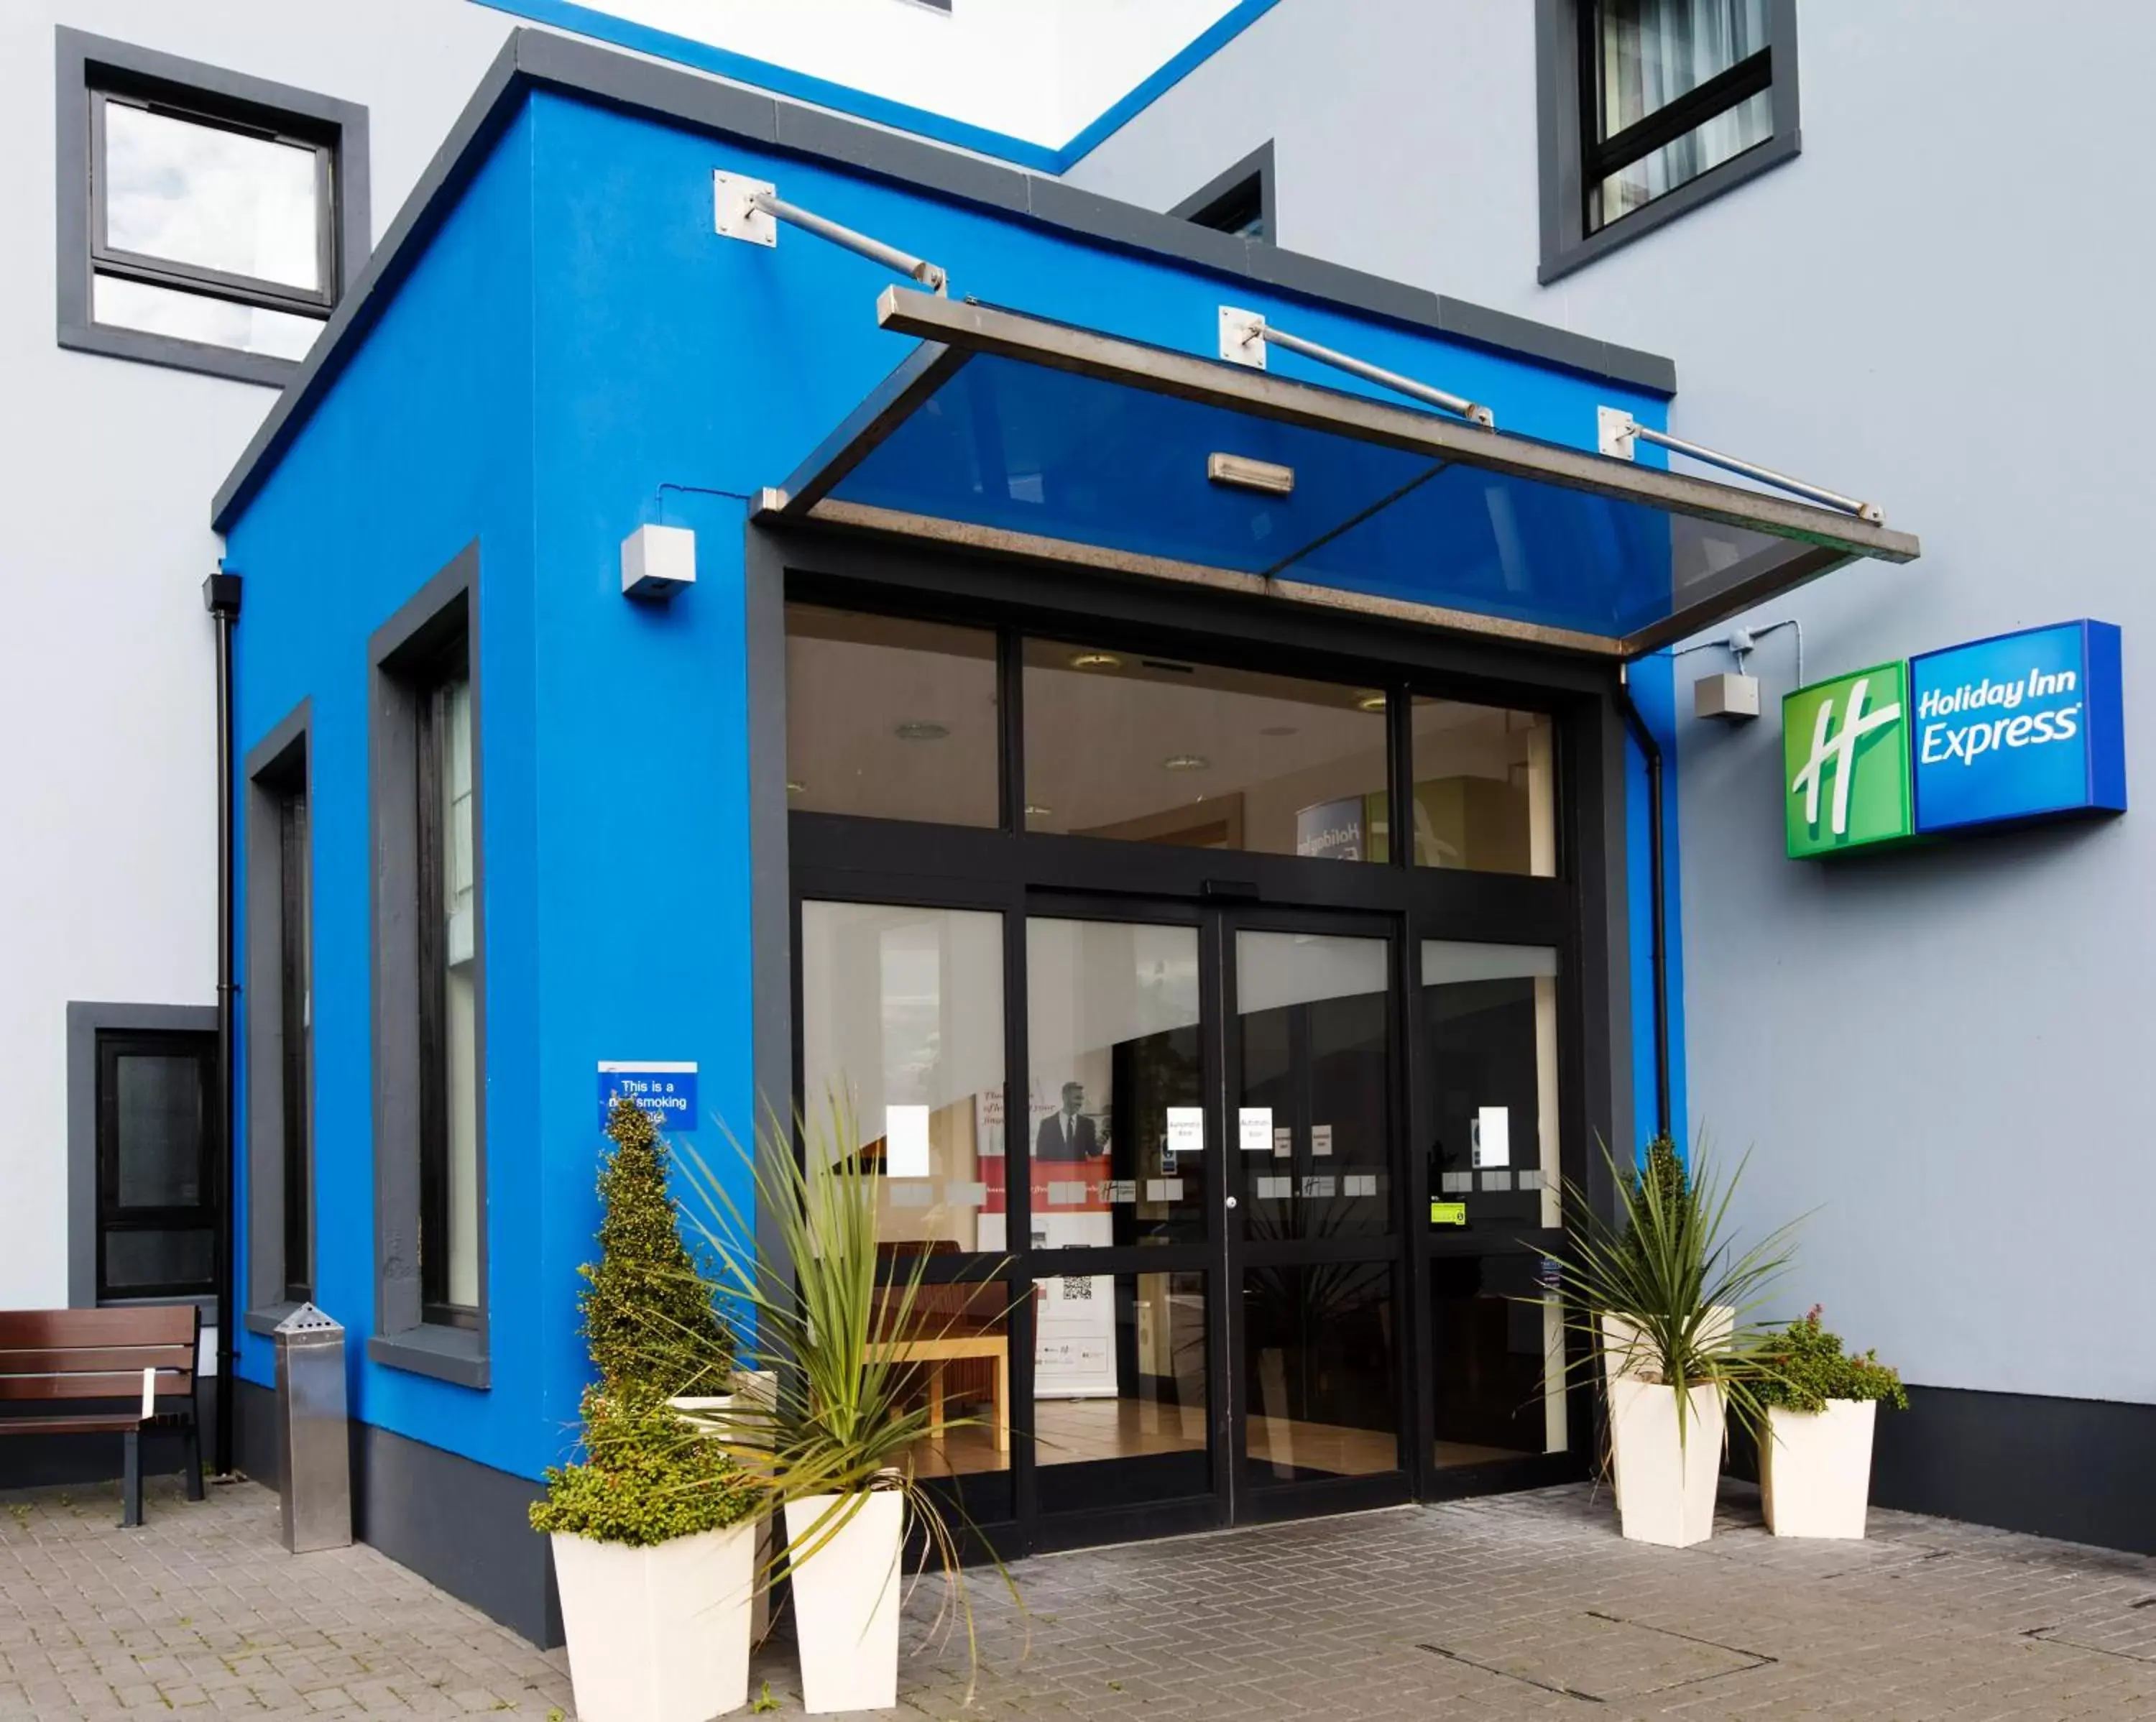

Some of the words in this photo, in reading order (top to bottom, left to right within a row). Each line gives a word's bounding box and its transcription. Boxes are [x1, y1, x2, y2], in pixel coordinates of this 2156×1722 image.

[1919, 676, 2027, 719] Holiday
[2028, 668, 2076, 699] Inn
[1921, 706, 2078, 765] Express
[621, 1080, 648, 1092] This
[652, 1080, 662, 1092] is
[666, 1083, 674, 1092] a
[636, 1096, 686, 1110] smoking
